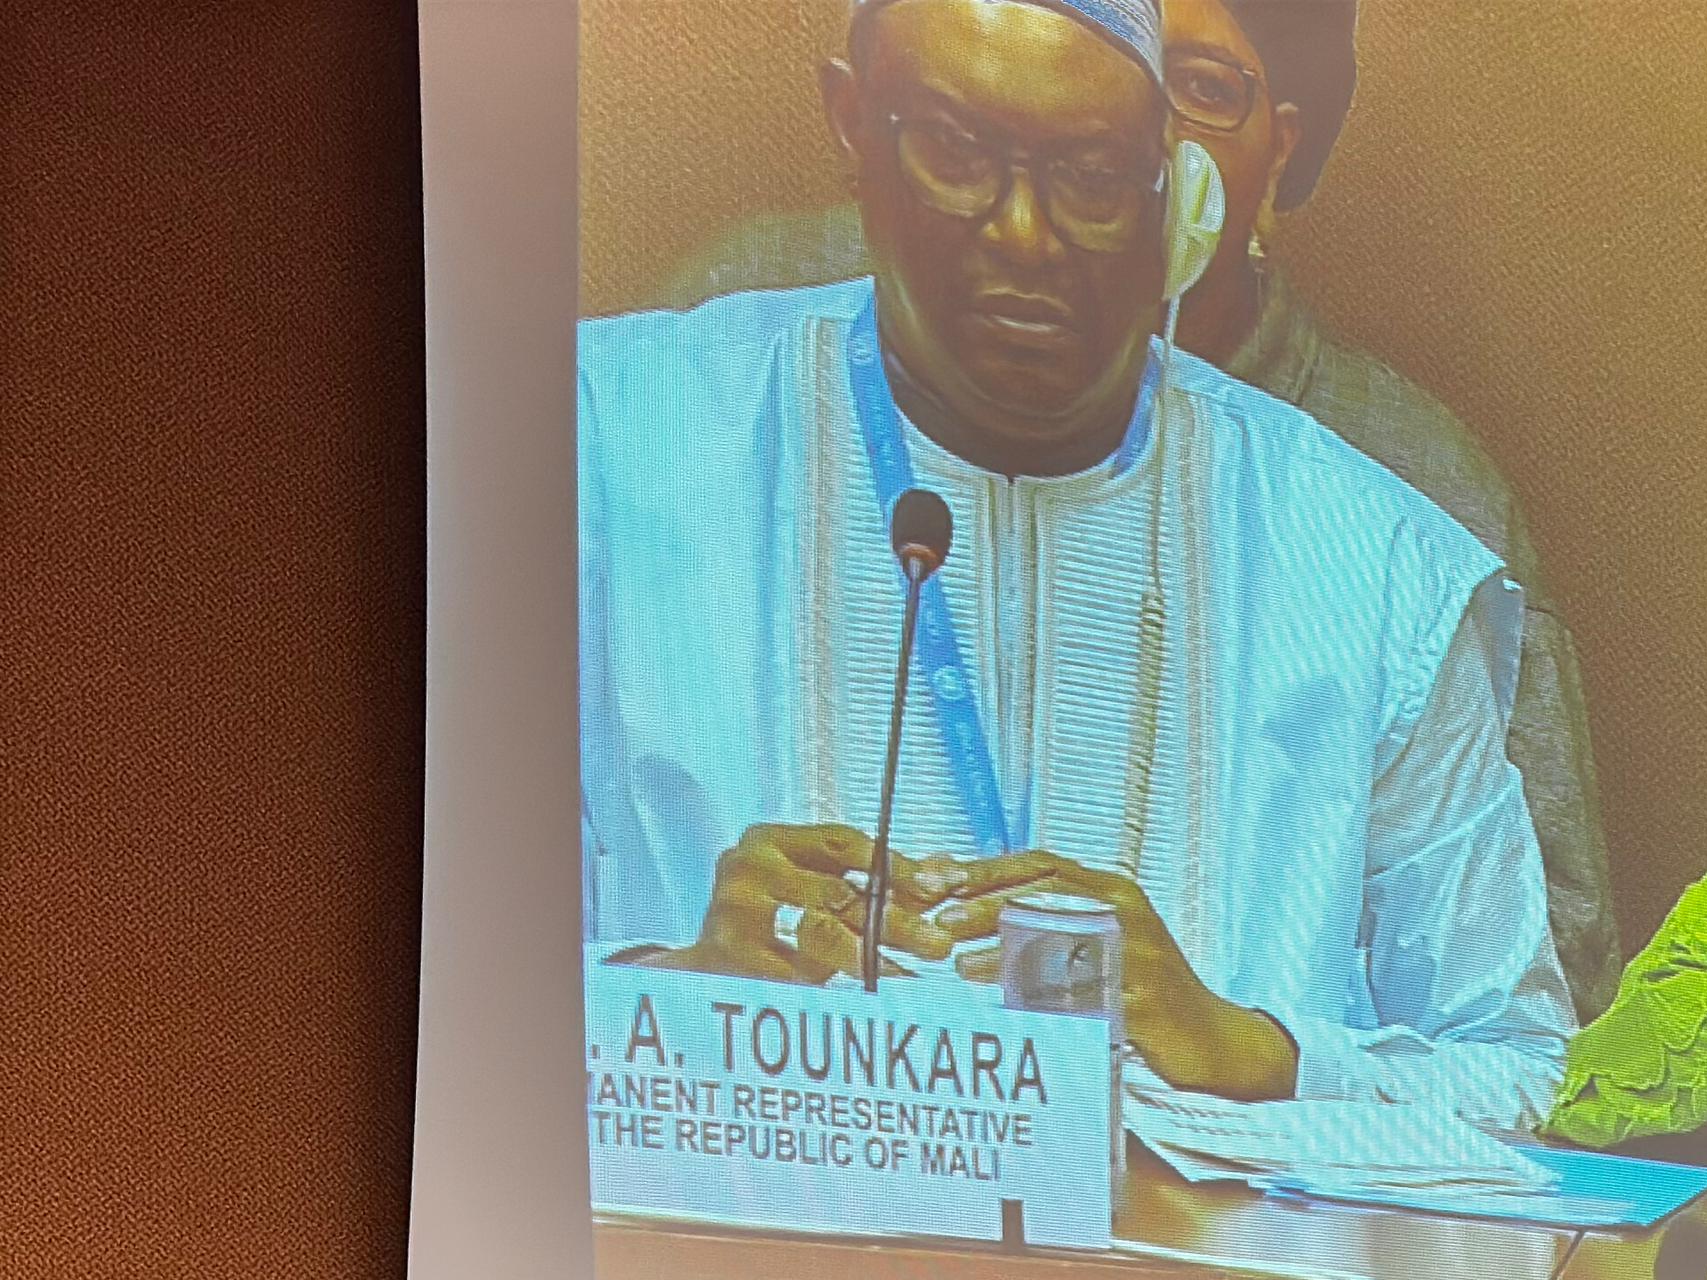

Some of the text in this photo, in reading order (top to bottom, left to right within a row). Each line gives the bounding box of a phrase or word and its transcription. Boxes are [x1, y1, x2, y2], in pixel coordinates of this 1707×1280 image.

[625, 994, 1048, 1104] A. TOUNKARA
[589, 1073, 1033, 1146] ANENT REPRESENTATIVE
[593, 1110, 999, 1181] THE REPUBLIC OF MALI
